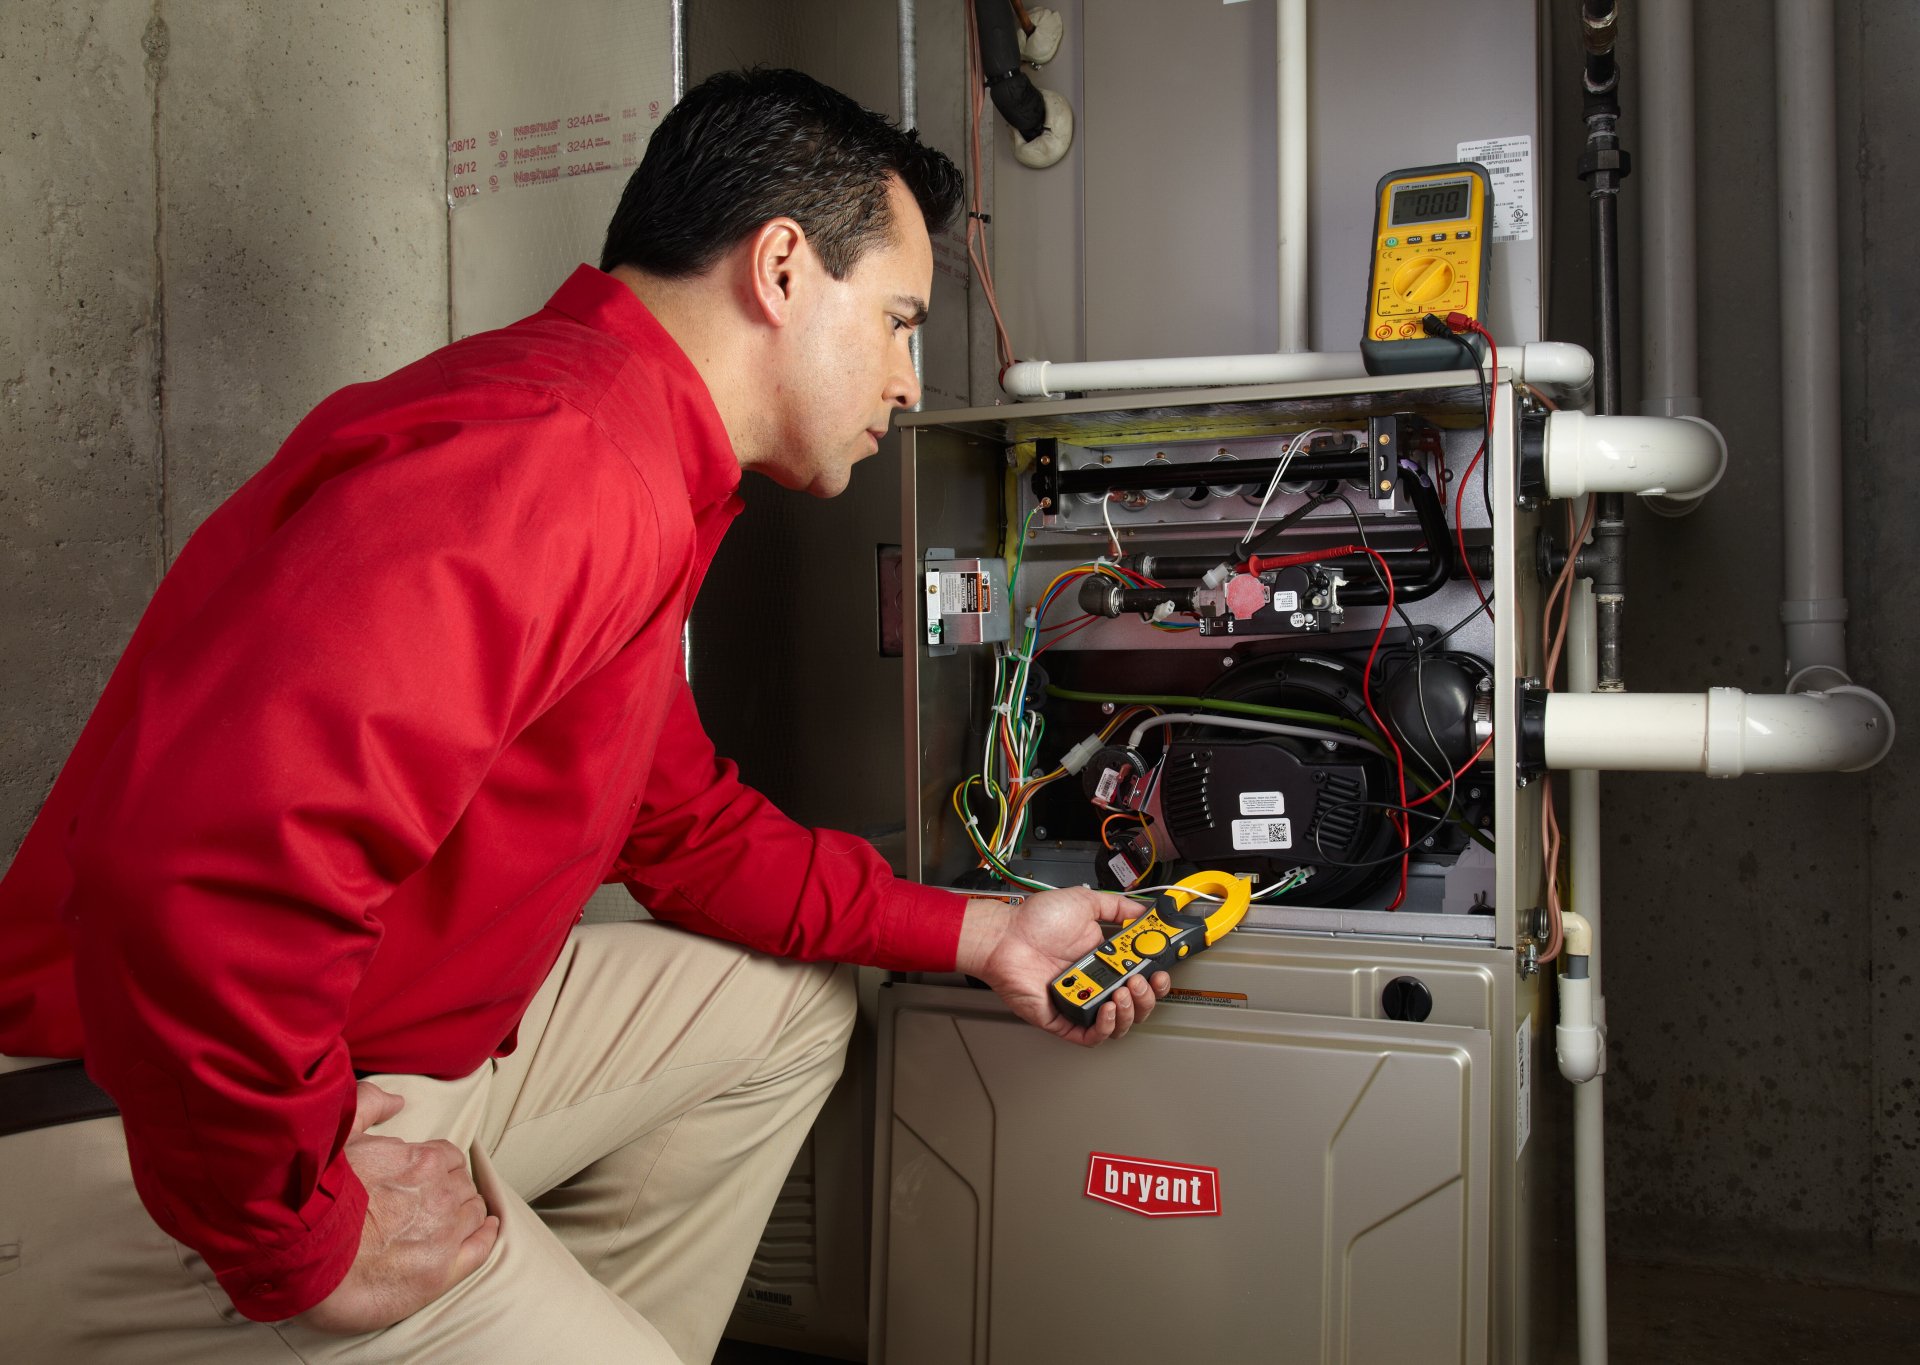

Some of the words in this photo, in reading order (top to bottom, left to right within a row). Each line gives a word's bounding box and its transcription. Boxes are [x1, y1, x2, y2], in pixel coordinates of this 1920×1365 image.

[514, 120, 558, 136] Nashua
[567, 114, 594, 129] 324A
[514, 144, 558, 160] Nashua
[567, 138, 594, 153] 324A
[514, 168, 559, 183] Nashua
[567, 162, 595, 177] 324A
[454, 184, 478, 198] 08/12
[1228, 621, 1233, 633] ON
[1104, 1163, 1202, 1206] bryant
[755, 1289, 792, 1306] WARNING
